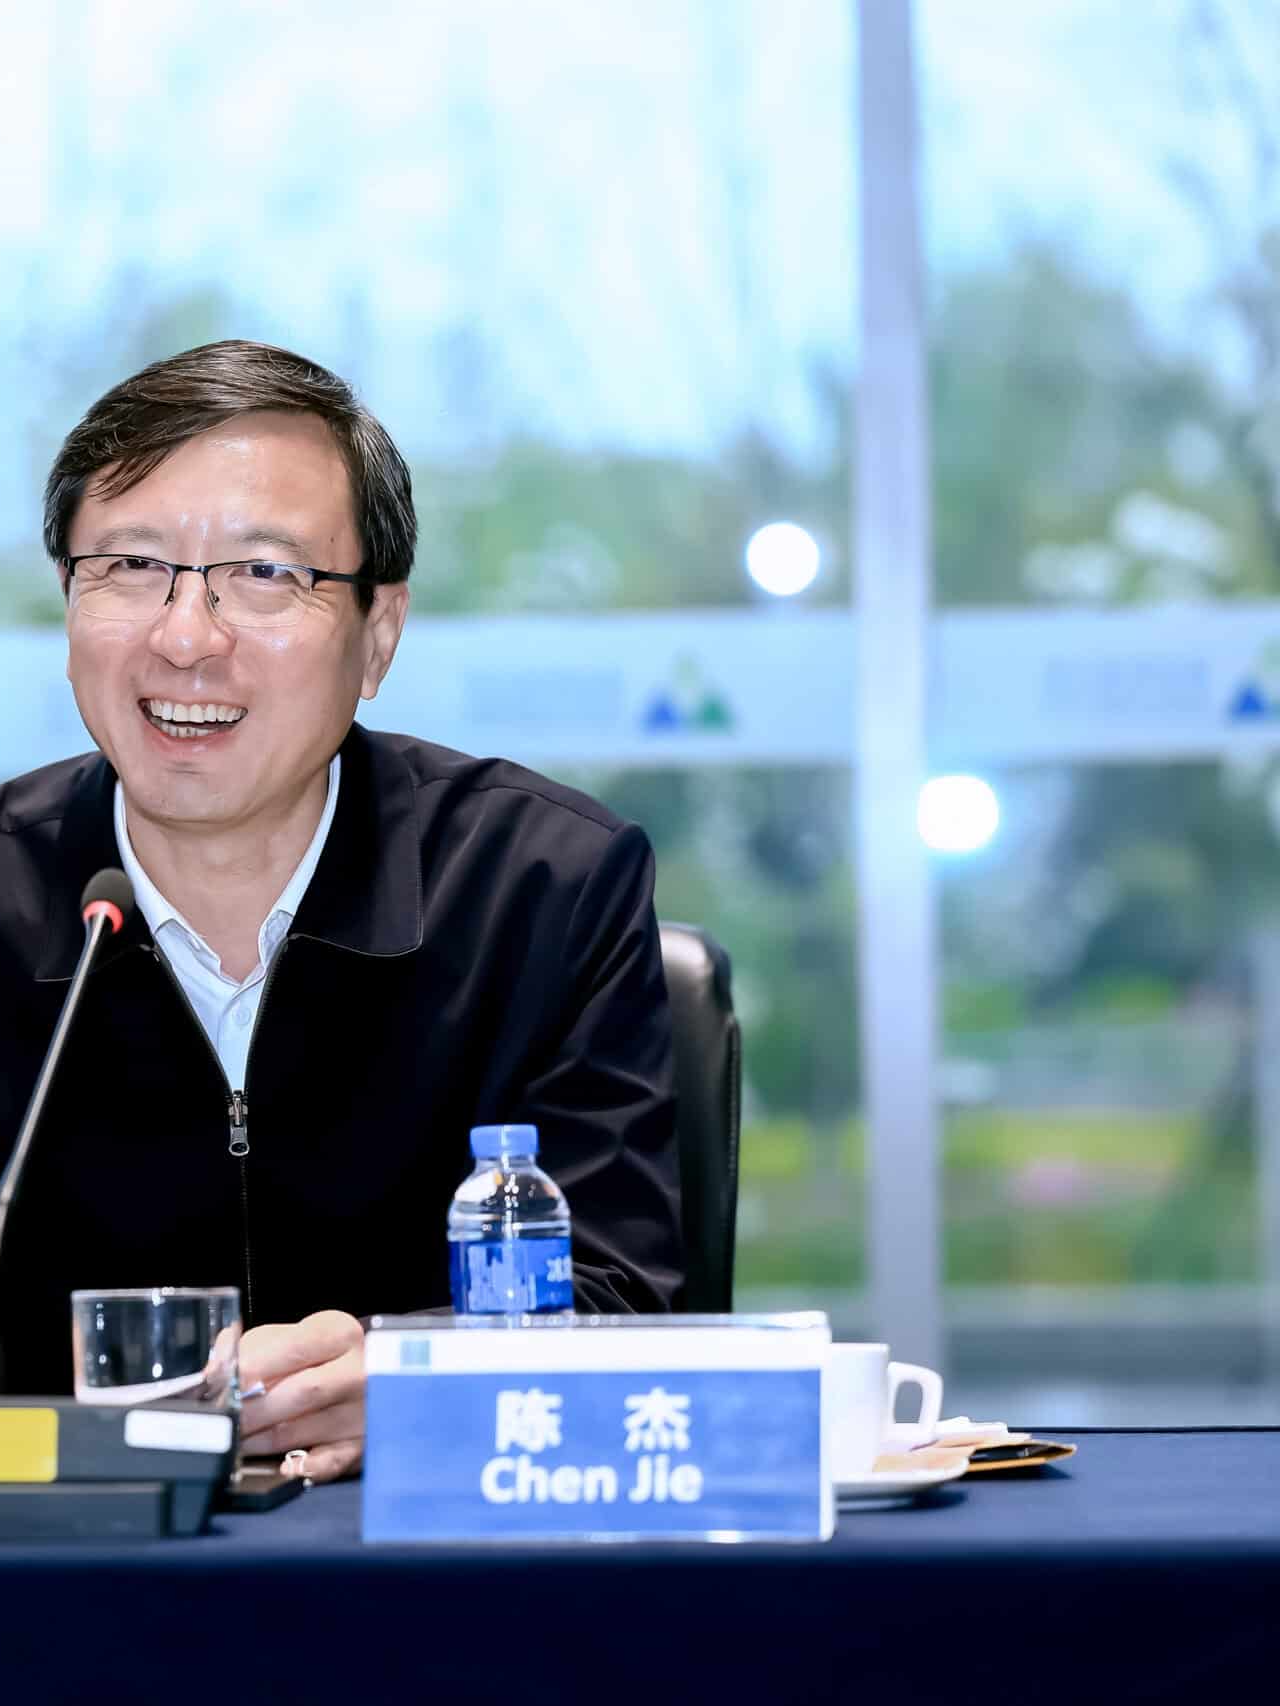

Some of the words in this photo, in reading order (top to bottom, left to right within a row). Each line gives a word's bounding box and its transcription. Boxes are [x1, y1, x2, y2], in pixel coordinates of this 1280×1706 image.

[495, 1387, 563, 1453] 陈
[623, 1386, 691, 1452] 杰
[480, 1454, 618, 1504] Chen
[628, 1453, 704, 1504] Jie
